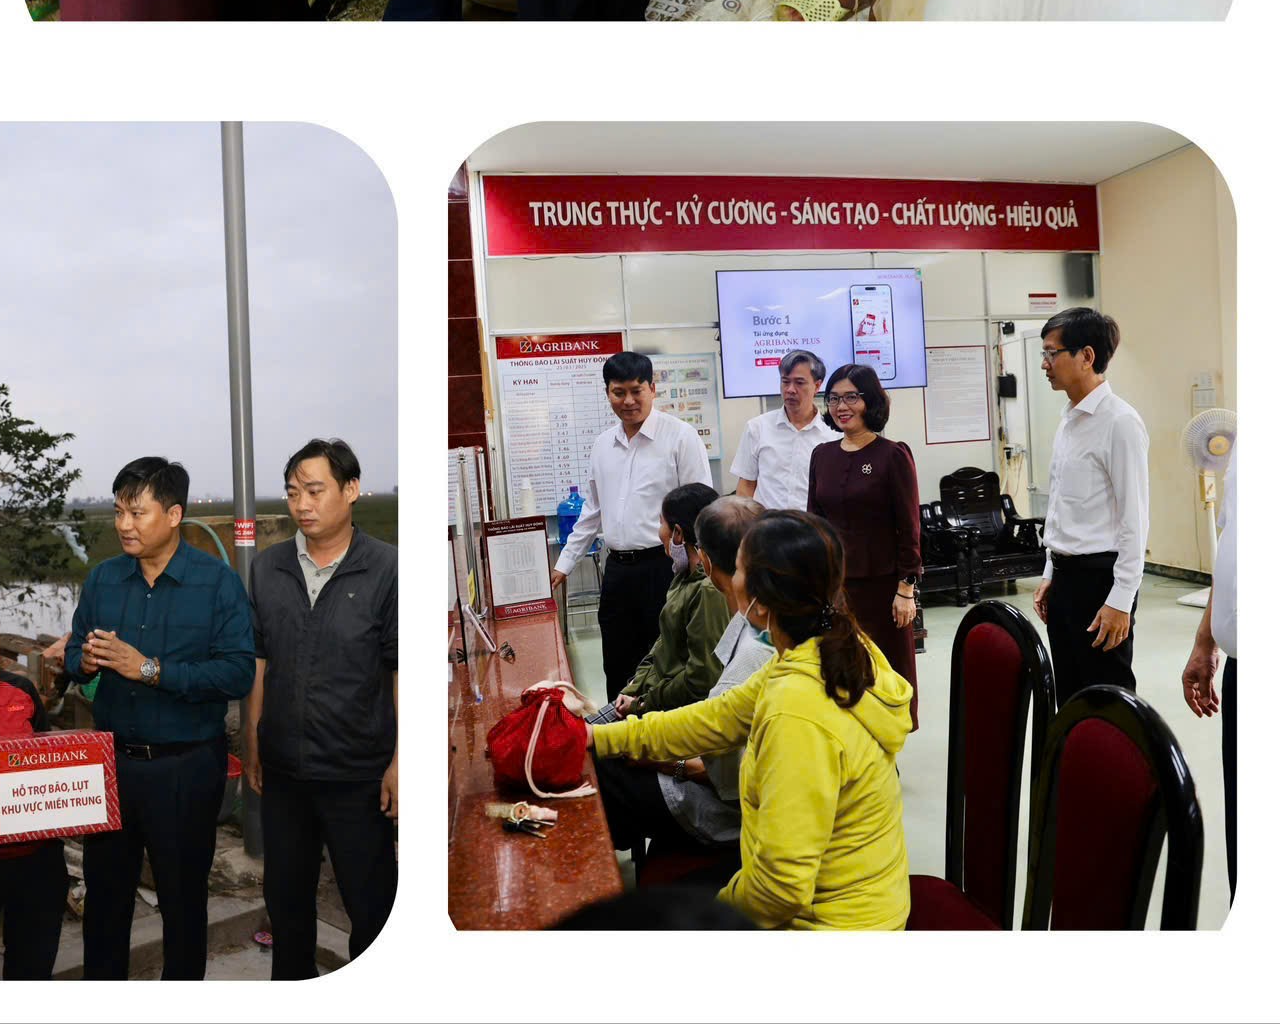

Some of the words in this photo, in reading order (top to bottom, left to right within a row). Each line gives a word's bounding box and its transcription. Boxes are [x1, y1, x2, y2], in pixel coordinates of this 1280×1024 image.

[529, 202, 603, 226] TRUNG
[606, 198, 663, 231] THỰC
[677, 194, 703, 225] KỶ
[708, 198, 776, 225] CƯƠNG
[790, 197, 840, 225] SÁNG
[842, 202, 879, 230] TẠO
[892, 198, 936, 226] CHẤT
[939, 201, 996, 232] LƯỢNG
[1006, 201, 1042, 232] HIỆU
[1048, 200, 1079, 229] QUẢ
[753, 315, 782, 325] Bước
[785, 315, 791, 325] 1
[534, 341, 599, 352] AGRIBANK
[754, 338, 799, 347] AGRIBANK
[22, 750, 88, 766] AGRIBANK
[28, 784, 47, 797] TRỢ
[49, 782, 70, 793] BÃO,
[72, 780, 89, 793] LỤT
[2, 804, 21, 815] KHU
[23, 802, 43, 814] VỰC
[45, 798, 69, 810] MIỀN
[70, 796, 102, 807] TRUNG
